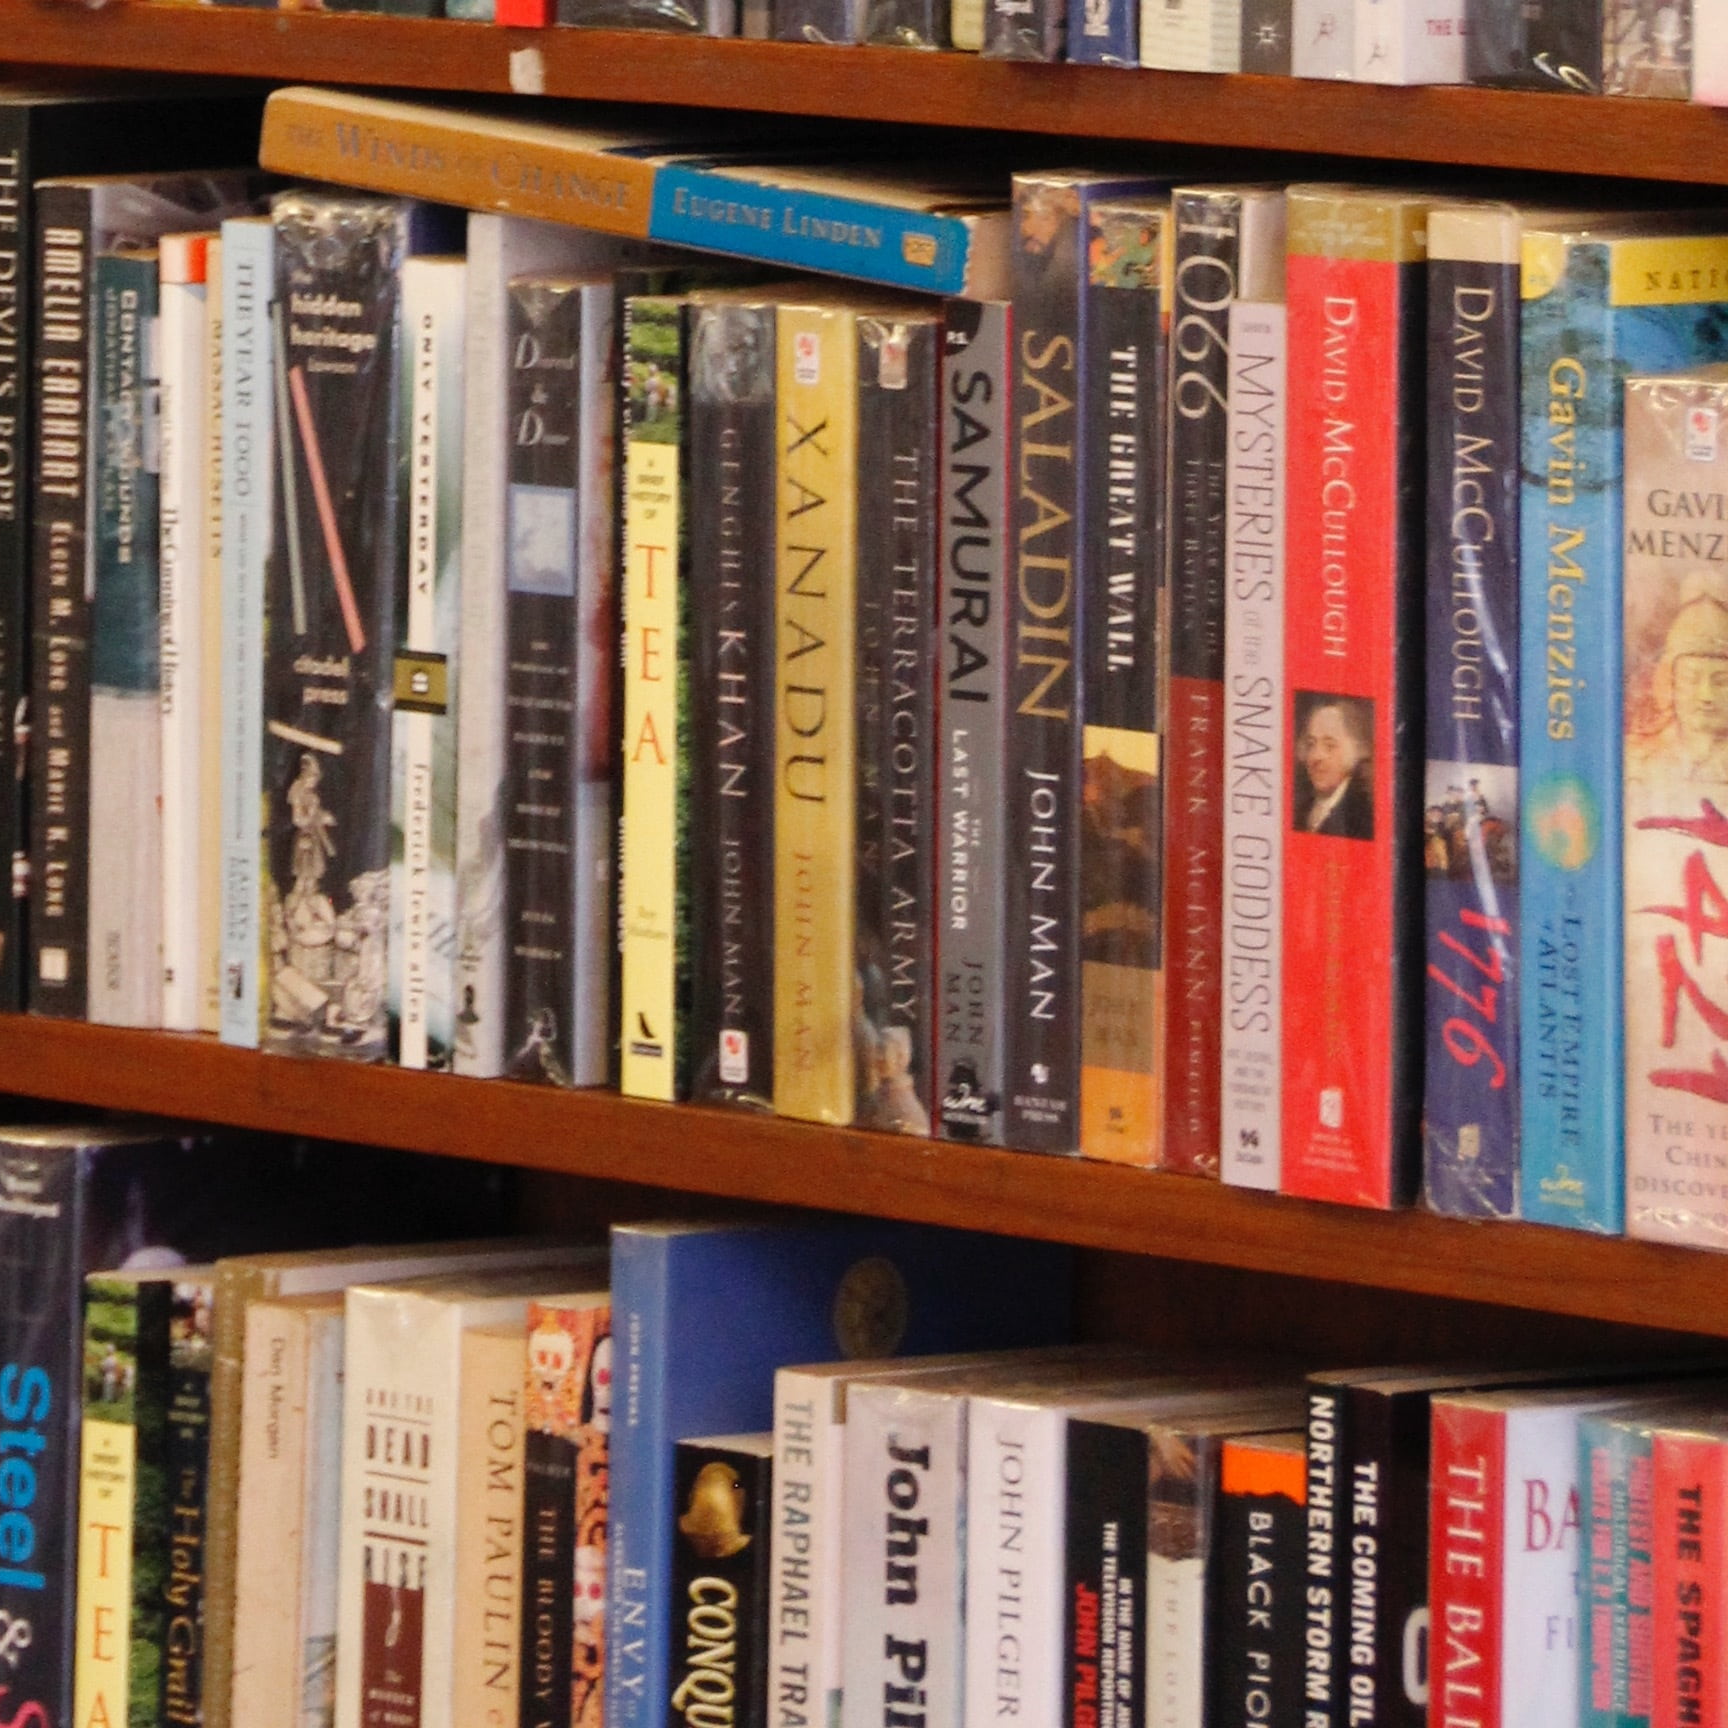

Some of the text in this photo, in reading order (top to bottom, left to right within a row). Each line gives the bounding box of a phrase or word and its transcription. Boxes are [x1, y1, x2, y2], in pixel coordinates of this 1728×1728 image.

[781, 412, 829, 807] XANADU
[946, 370, 993, 704] SAMURAI
[1014, 329, 1074, 724] SALADIN
[1544, 356, 1585, 741] Gavin Menzies
[888, 447, 921, 1026] THE TERRACOTTA ARMY
[949, 728, 971, 930] LAST WARRIOR
[1229, 353, 1277, 1033] MYSTERIES of the SNAKE GODDESS
[1025, 768, 1061, 1024] JOHN MAN
[1426, 906, 1510, 1089] 1776
[883, 1432, 931, 1606] John
[1304, 1396, 1335, 1700] NORTHERN STORM
[1350, 1462, 1378, 1726] THE COMING OIL
